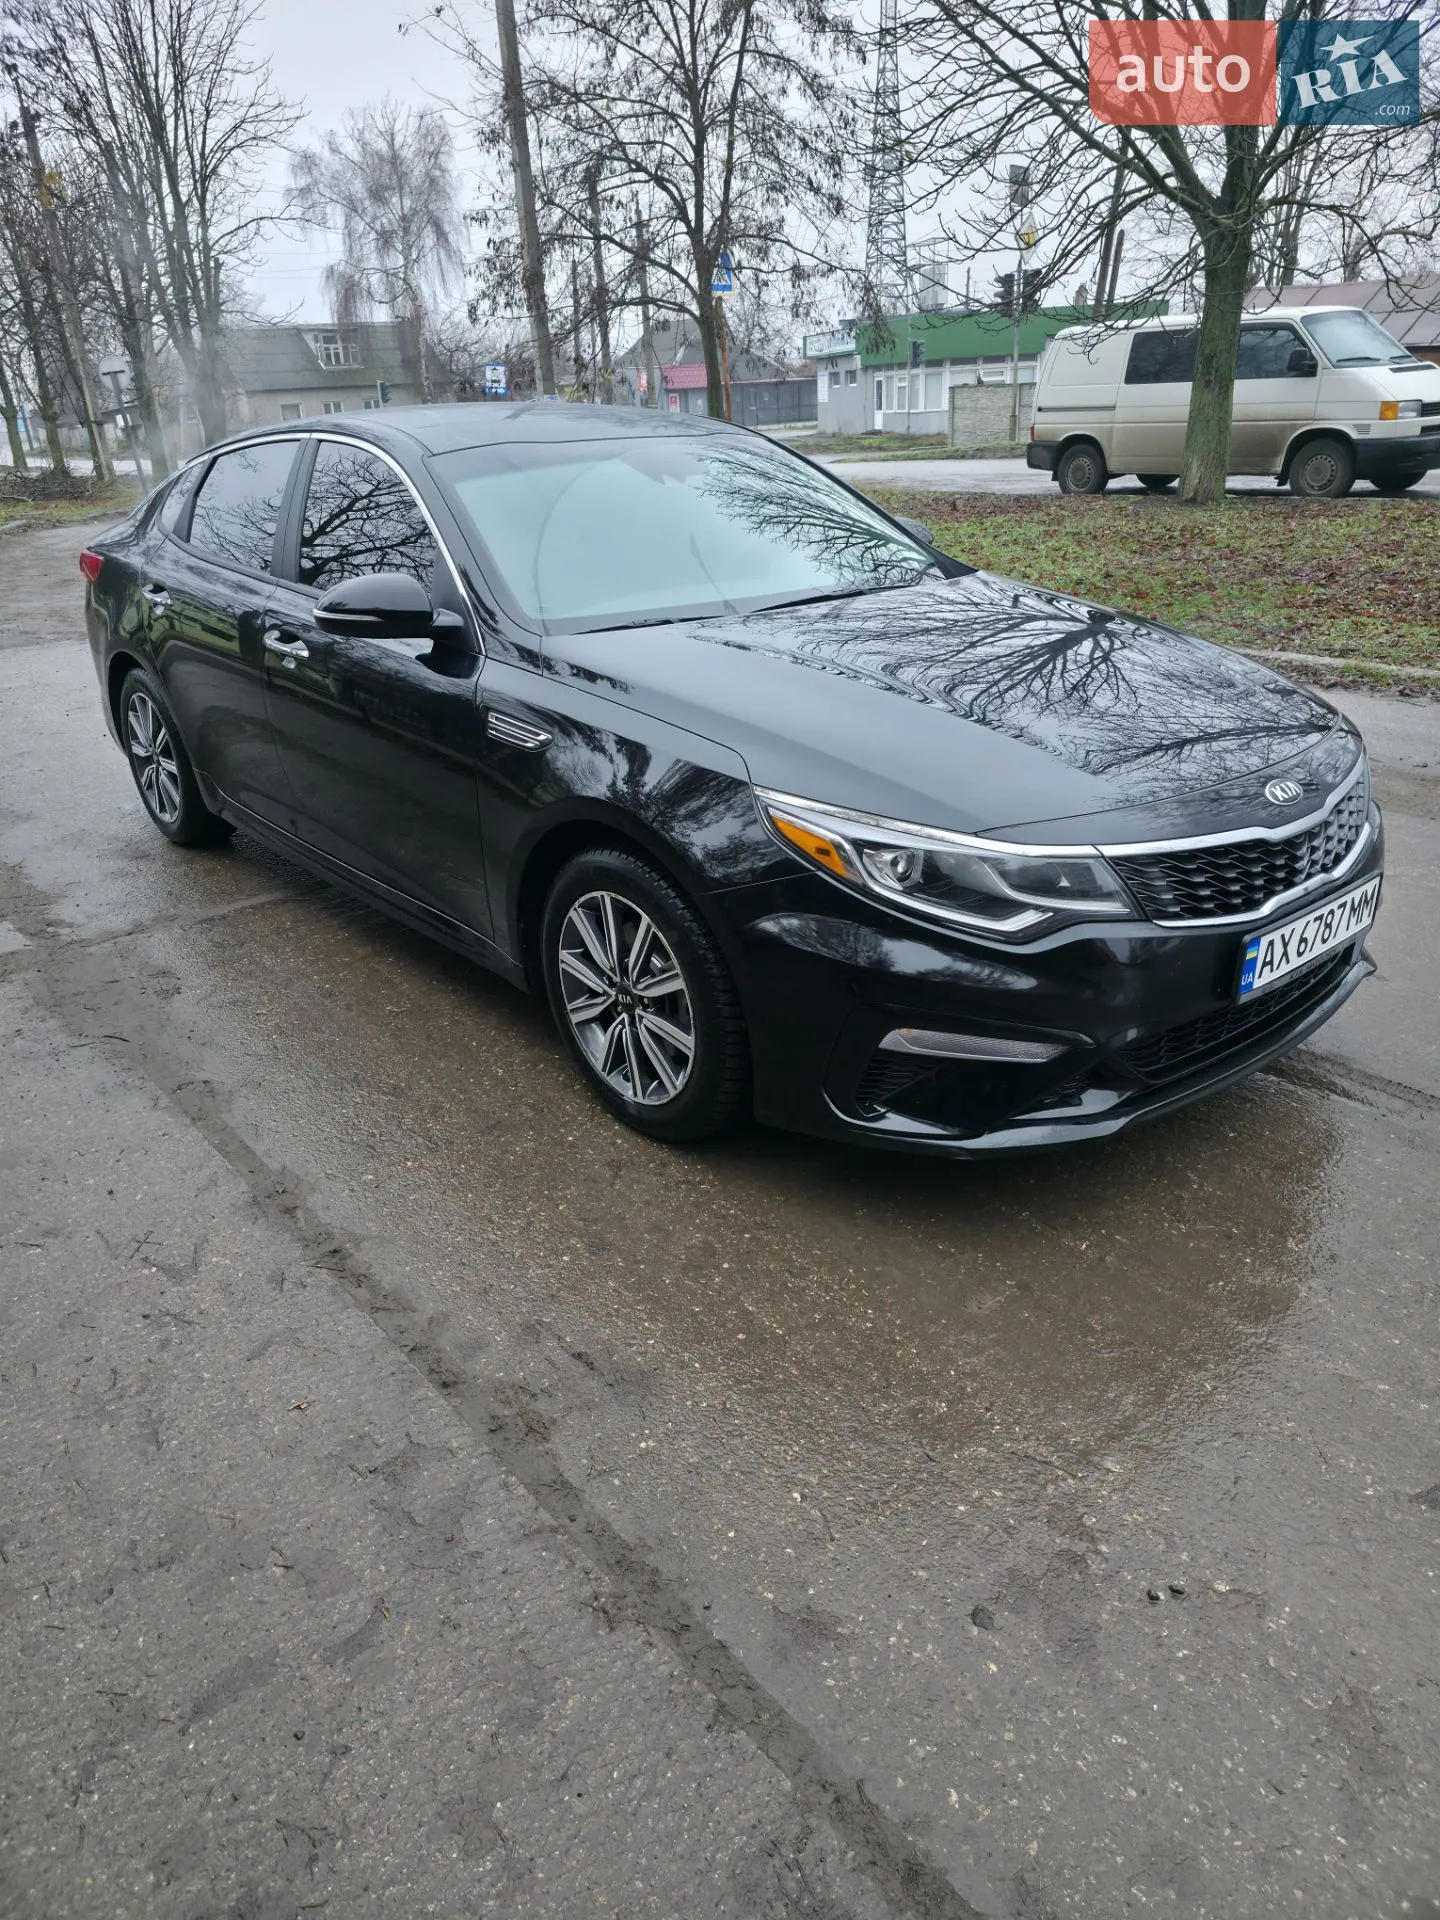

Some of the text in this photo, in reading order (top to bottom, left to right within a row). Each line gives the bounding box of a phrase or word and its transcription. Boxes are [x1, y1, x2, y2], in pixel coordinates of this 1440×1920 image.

[1270, 781, 1301, 801] KIA
[1241, 972, 1254, 985] UA
[618, 994, 632, 1004] KIA
